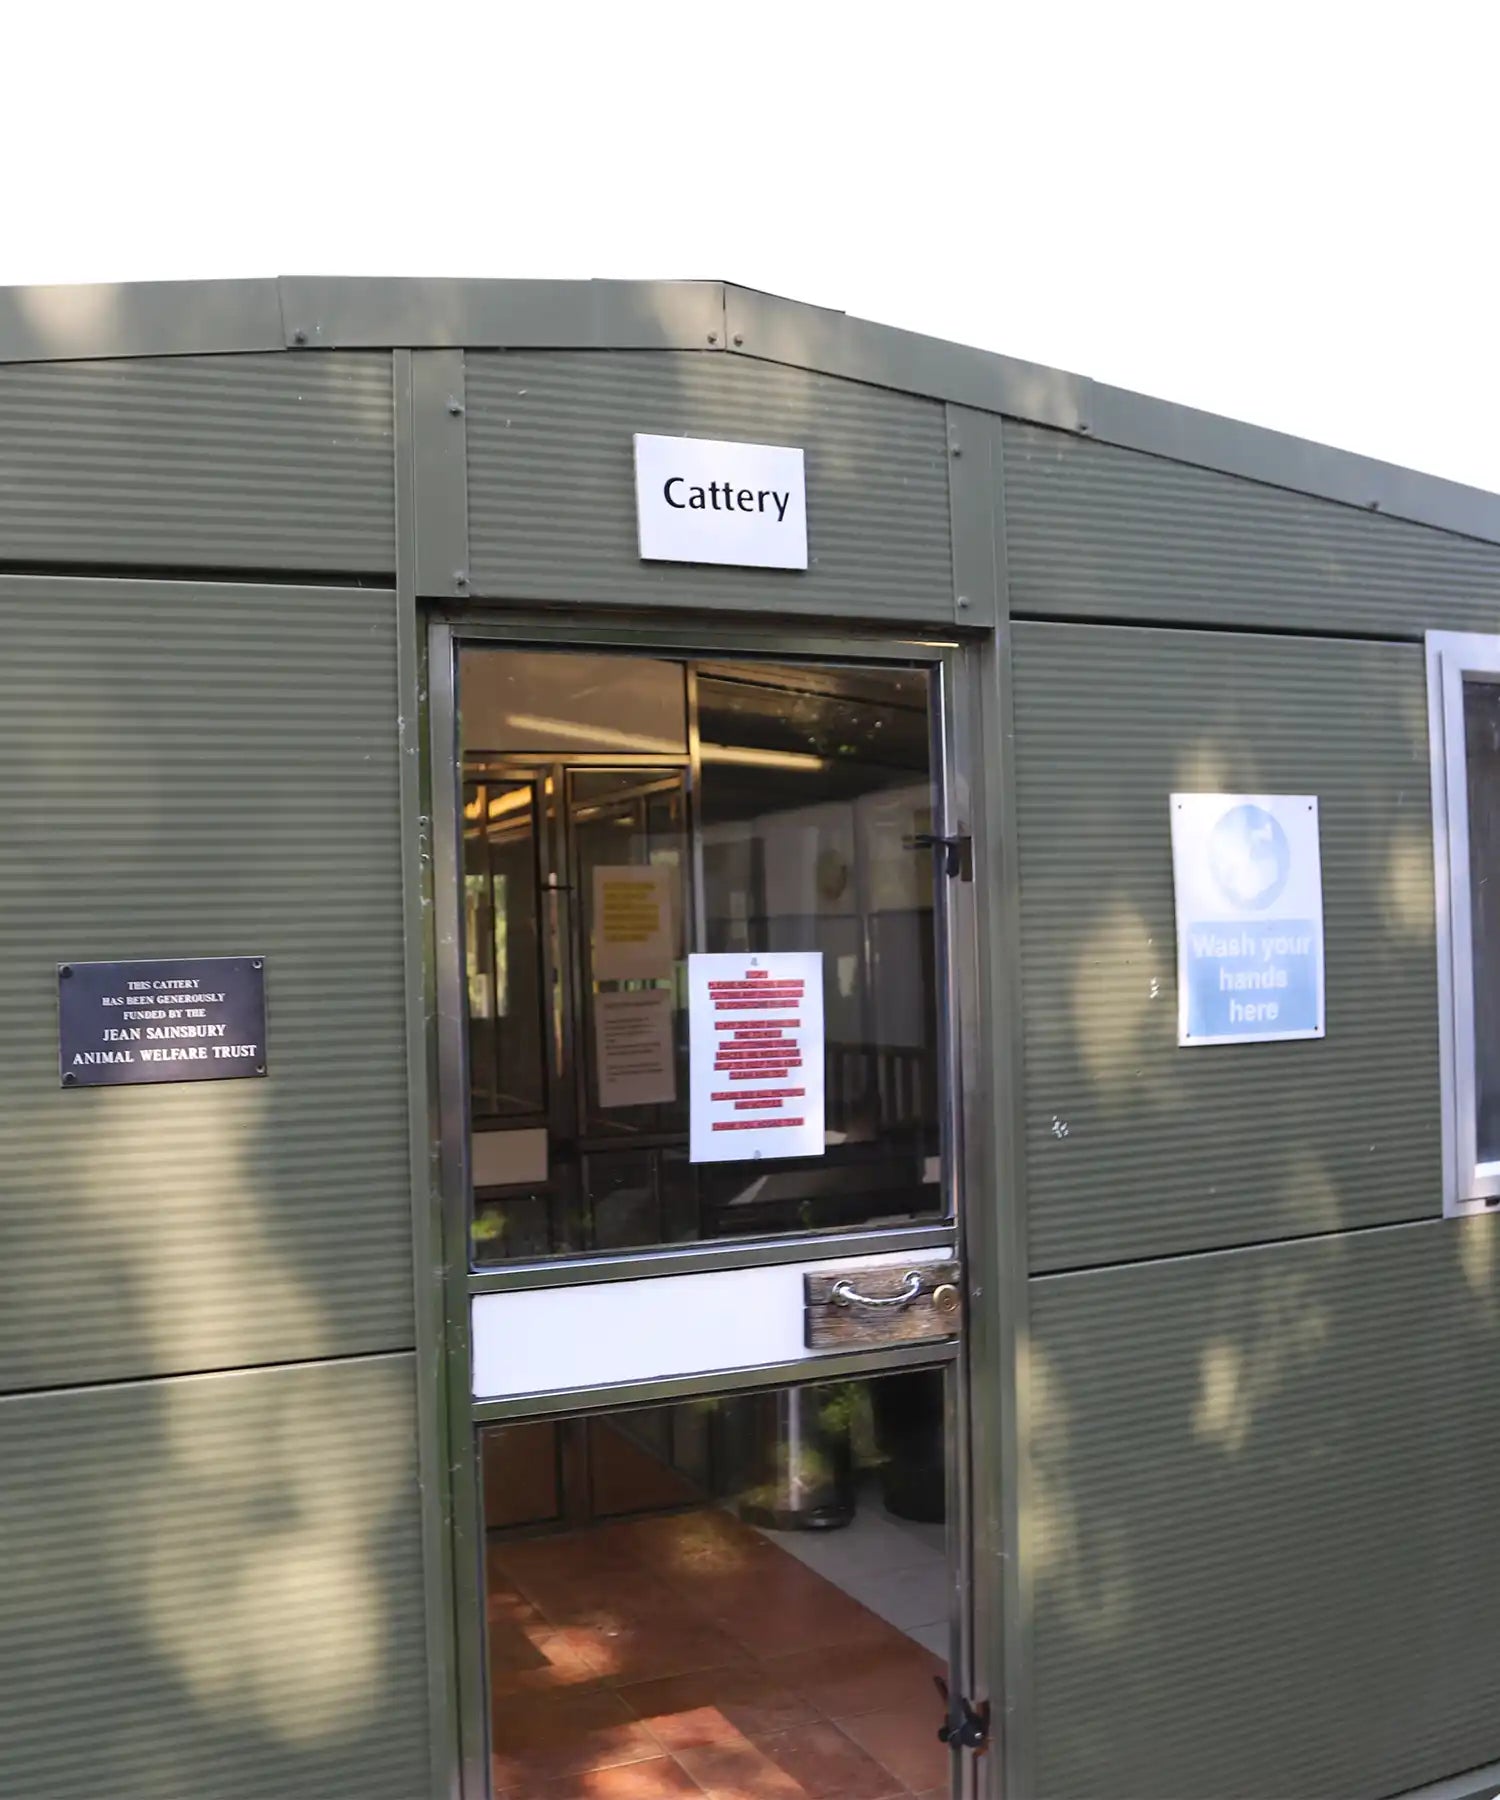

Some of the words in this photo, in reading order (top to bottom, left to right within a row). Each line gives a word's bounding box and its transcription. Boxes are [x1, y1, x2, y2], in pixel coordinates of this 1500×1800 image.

[664, 477, 789, 522] Cattery
[1192, 930, 1255, 957] Wash
[1261, 934, 1312, 961] your
[128, 980, 151, 990] THIS
[153, 979, 200, 989] CATTERY
[1219, 964, 1288, 991] hands
[102, 996, 124, 1006] HAS
[126, 995, 154, 1005] BEEN
[157, 993, 225, 1004] GENEROUSLY
[1230, 996, 1279, 1024] here
[123, 1010, 166, 1020] FUNDED
[169, 1009, 182, 1019] BY
[186, 1008, 206, 1018] THE
[102, 1028, 141, 1042] JEAN
[146, 1024, 226, 1039] SAINSBURY
[73, 1050, 134, 1065] ANIMAL
[140, 1046, 207, 1062] WELFARE
[212, 1044, 257, 1059] TRUST
